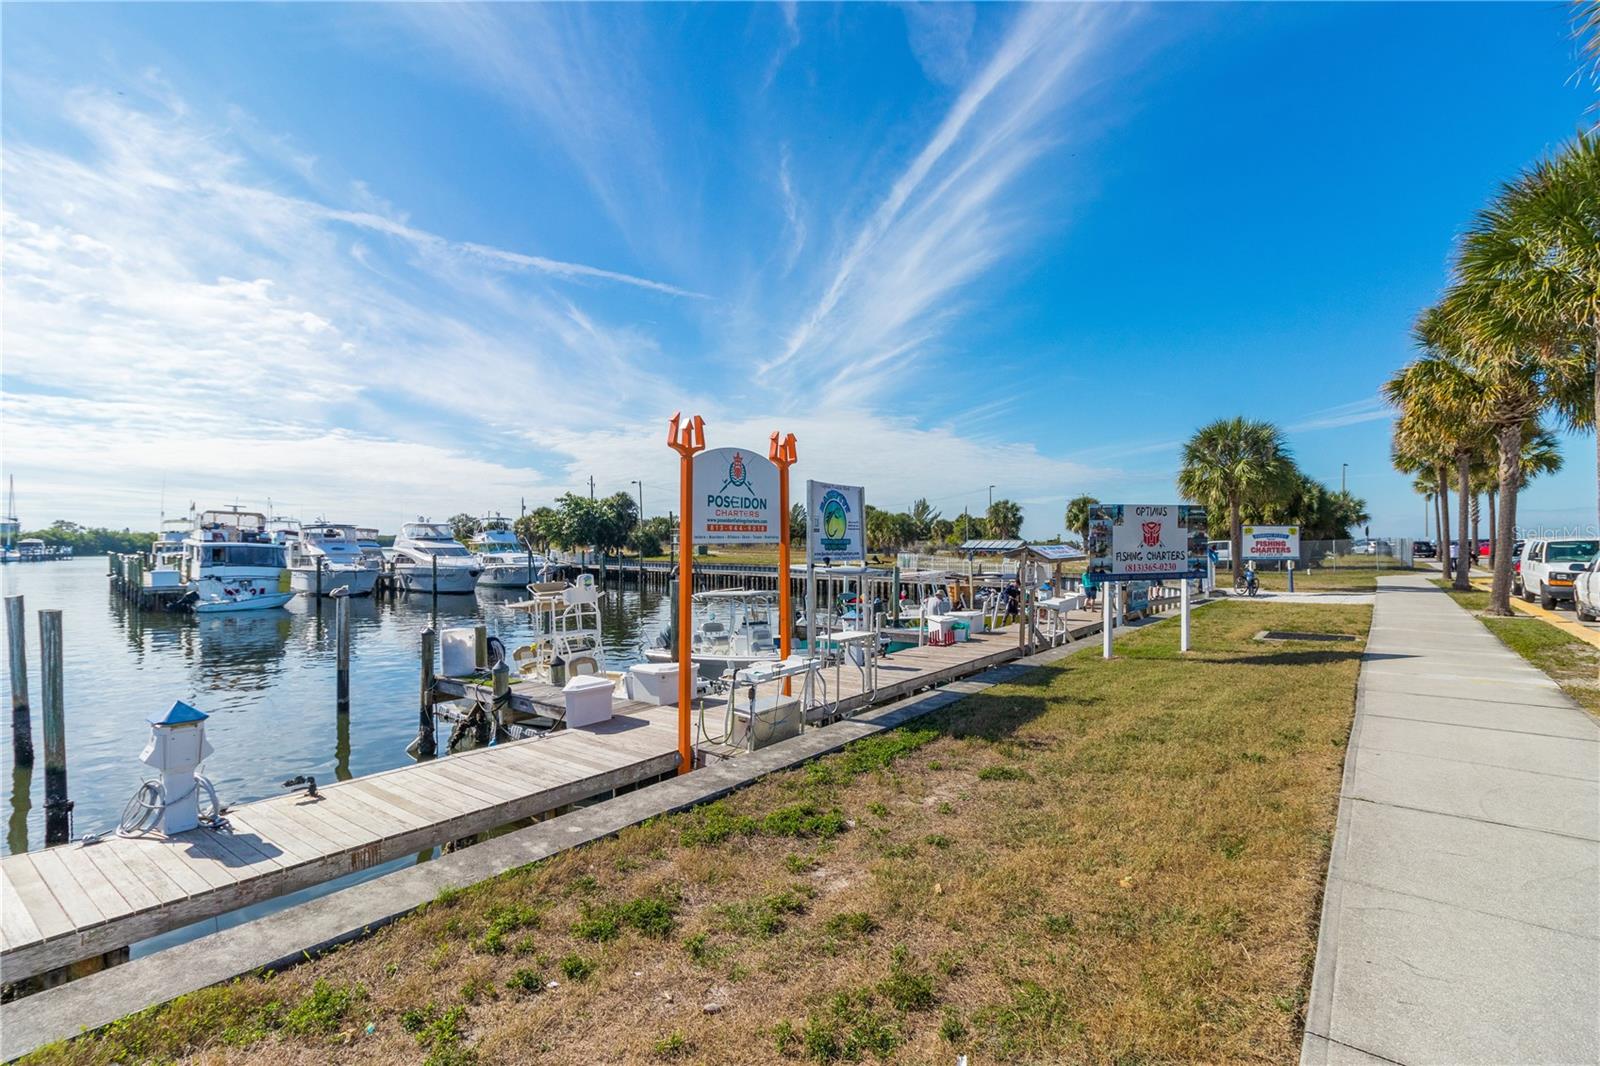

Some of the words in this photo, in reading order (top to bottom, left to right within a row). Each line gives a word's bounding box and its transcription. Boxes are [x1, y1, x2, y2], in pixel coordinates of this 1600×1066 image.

[707, 495, 767, 510] POSEIDON
[715, 509, 760, 518] CHARTERS
[1136, 506, 1168, 517] OPTIMUS
[1250, 546, 1292, 554] CHARTERS
[1116, 552, 1143, 561] FISHING
[1146, 551, 1186, 561] CHARTERS
[1125, 562, 1177, 573] (813)365-0230
